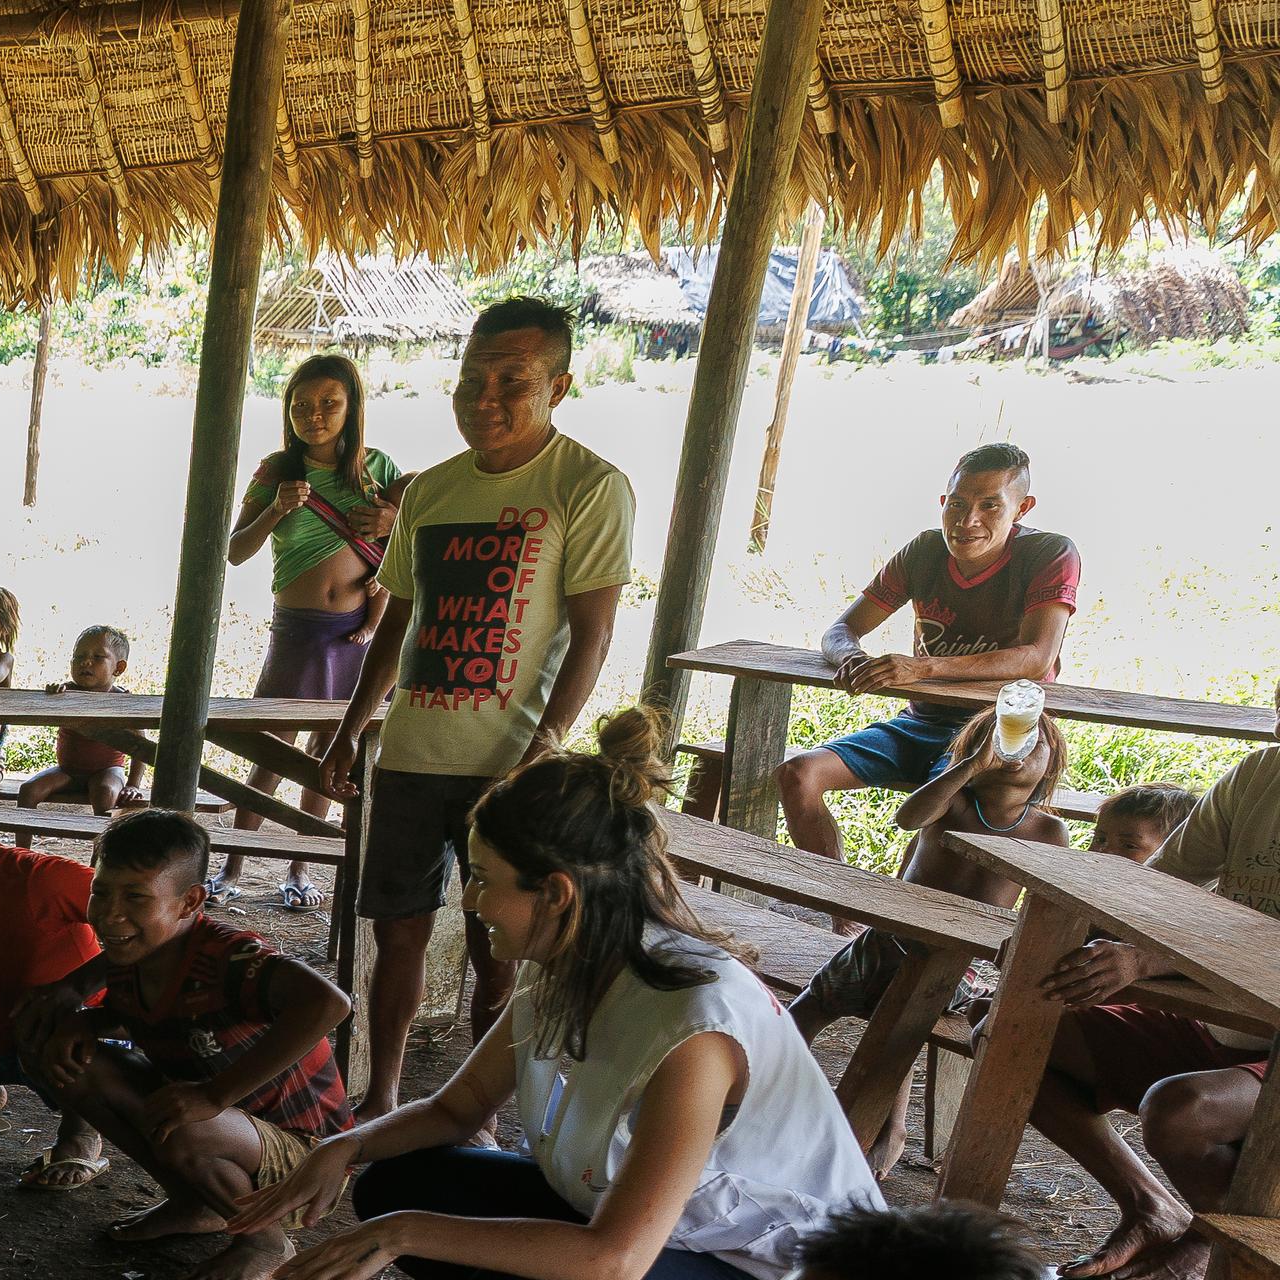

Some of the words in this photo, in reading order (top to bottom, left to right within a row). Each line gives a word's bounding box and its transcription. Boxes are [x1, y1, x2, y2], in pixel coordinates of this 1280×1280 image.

[496, 507, 549, 532] DO
[443, 536, 543, 563] MORE
[487, 566, 536, 593] OF
[437, 596, 530, 624] WHAT
[417, 625, 522, 653] MAKES
[443, 656, 518, 684] YOU
[410, 684, 514, 711] HAPPY
